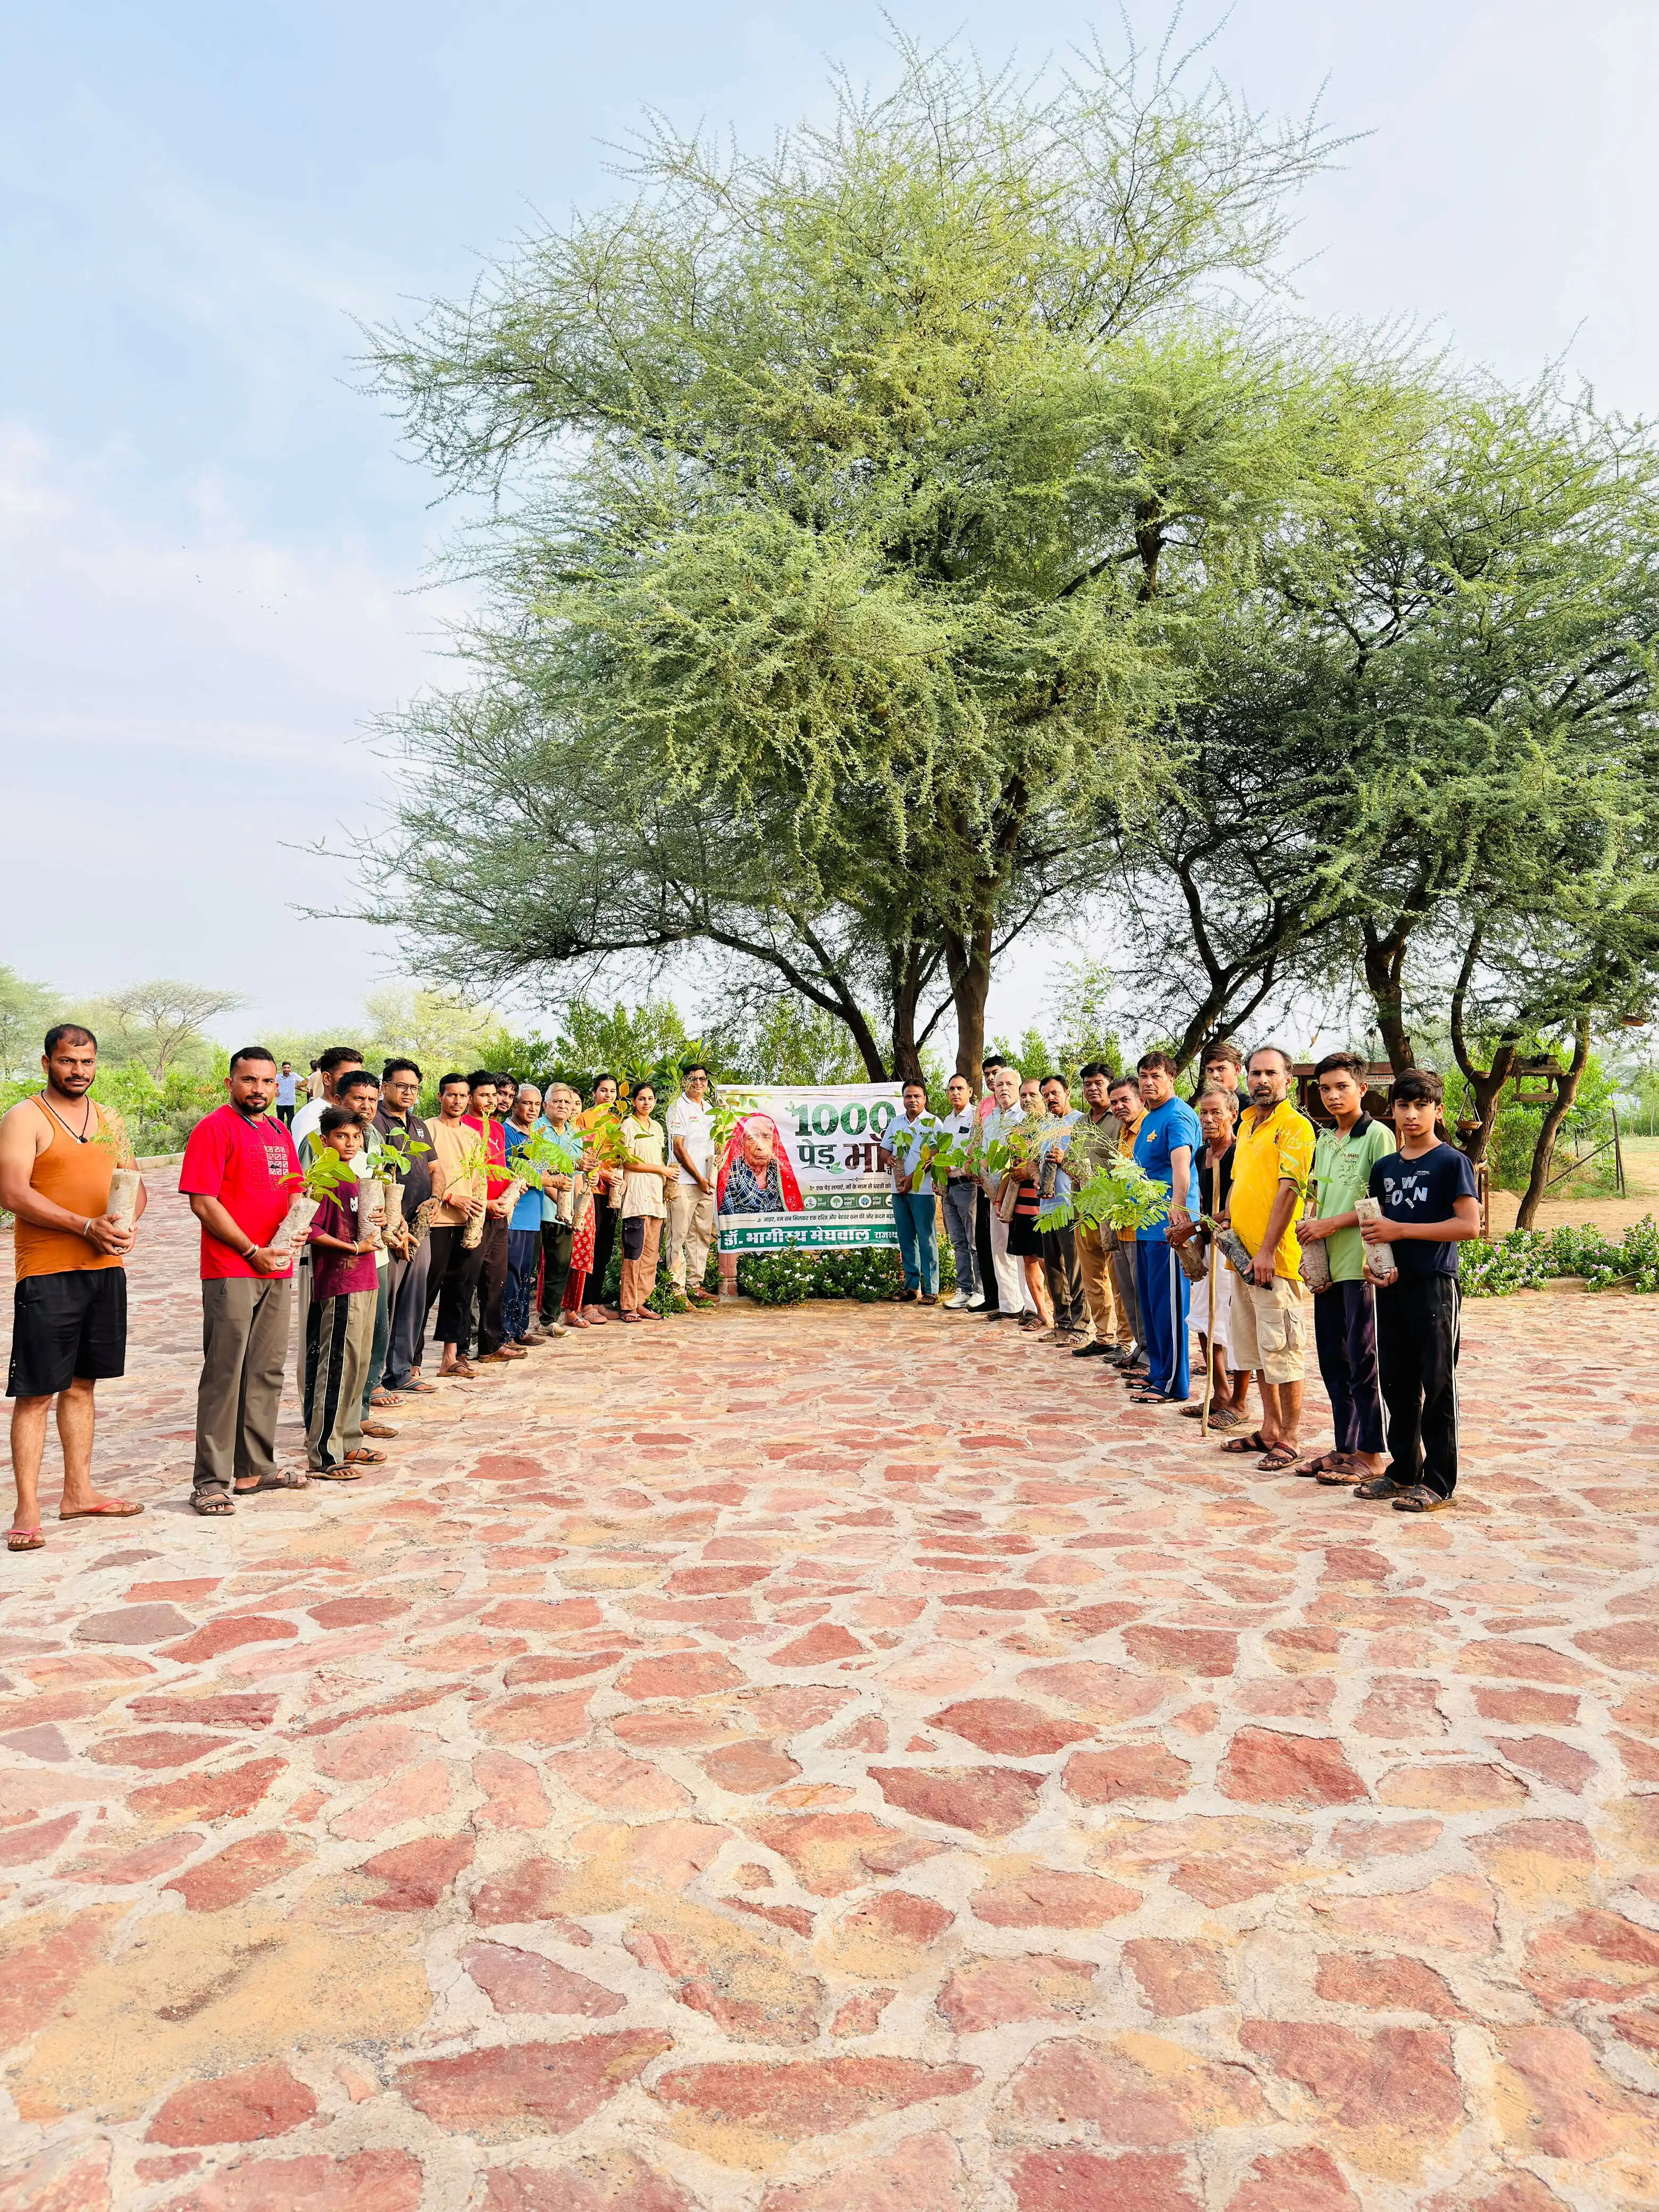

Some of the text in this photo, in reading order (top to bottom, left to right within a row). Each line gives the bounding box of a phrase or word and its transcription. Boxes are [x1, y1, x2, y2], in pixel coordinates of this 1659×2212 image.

[792, 1101, 896, 1136] 1000
[797, 1139, 837, 1169] पेड़
[724, 1229, 743, 1246] डॉ.
[810, 1226, 871, 1242] मेघवाल
